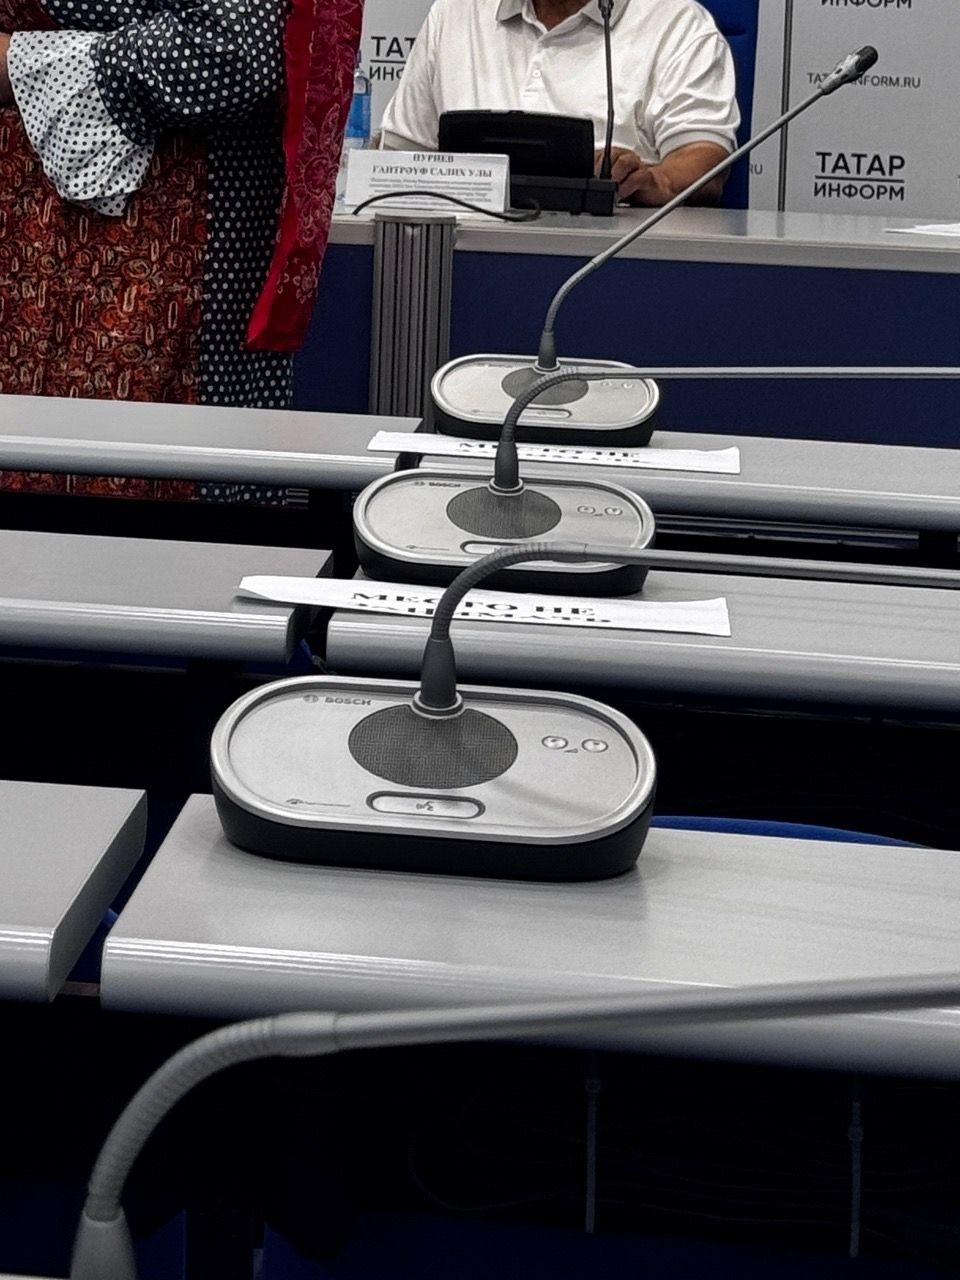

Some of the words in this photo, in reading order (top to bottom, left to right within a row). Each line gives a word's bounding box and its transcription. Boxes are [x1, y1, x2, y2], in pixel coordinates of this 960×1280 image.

[815, 151, 905, 176] ТАТАР
[814, 182, 905, 200] ИНФОРМ
[325, 696, 372, 706] BOSCH
